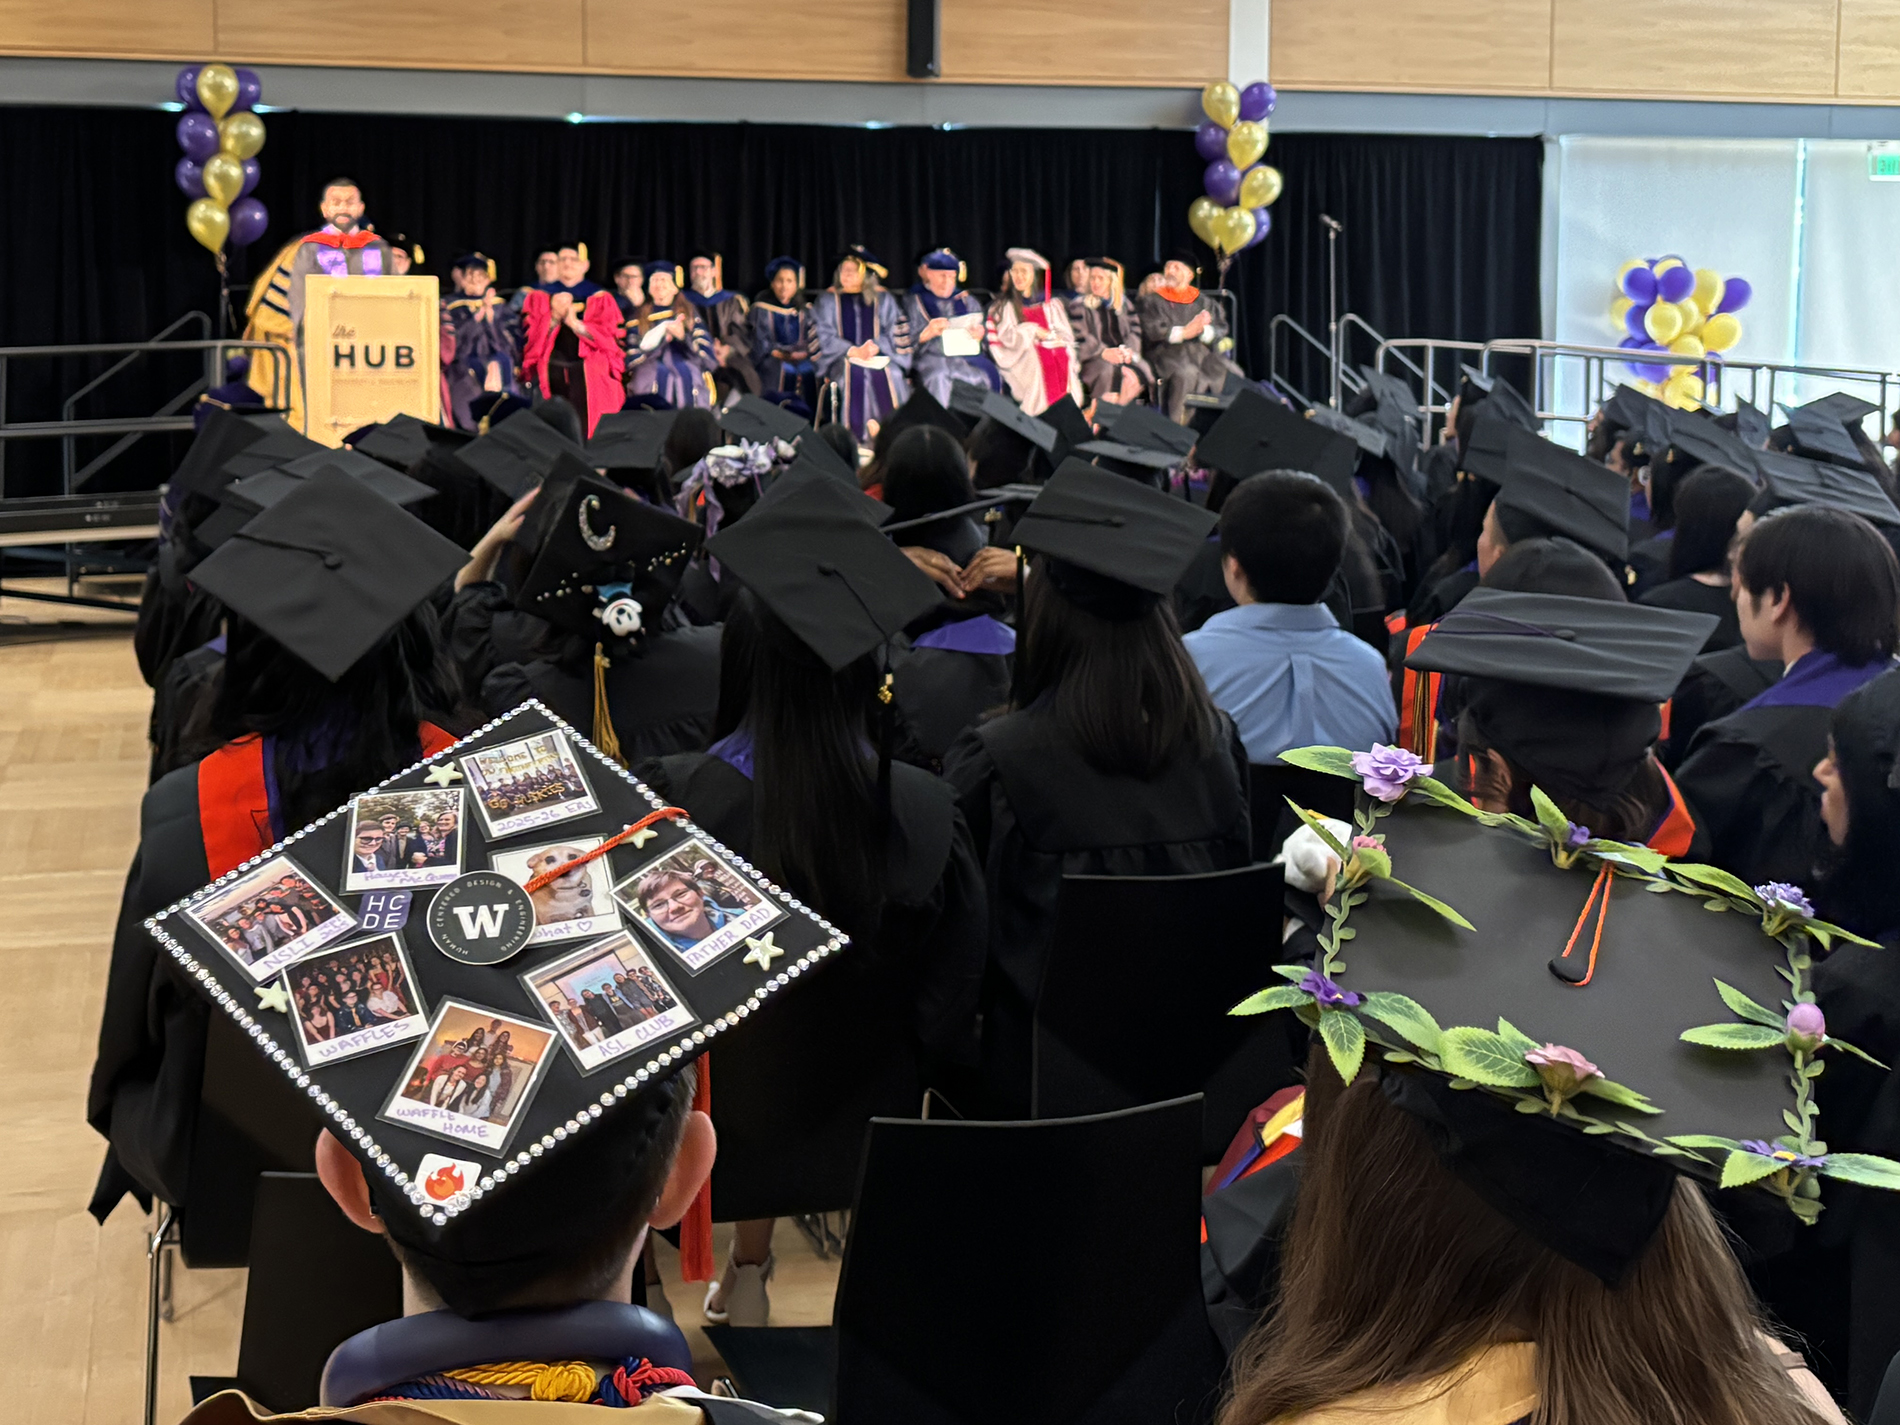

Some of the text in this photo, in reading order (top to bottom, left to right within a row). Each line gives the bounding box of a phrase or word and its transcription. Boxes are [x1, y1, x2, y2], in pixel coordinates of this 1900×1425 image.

[334, 344, 415, 369] HUB
[498, 810, 560, 832] 2025-26
[467, 879, 502, 889] DESIGN
[367, 895, 405, 912] HC
[436, 887, 461, 928] CENTERED
[362, 913, 402, 929] DE
[452, 903, 510, 940] W
[500, 899, 528, 952] ENGINEERING
[441, 933, 469, 956] HUMAN
[685, 908, 771, 965] FATHER DAD
[263, 937, 315, 970] NSLI
[319, 1022, 410, 1058] WAFFLES
[598, 1014, 675, 1058] ASL CLUB
[397, 1108, 455, 1121] WAFFLE
[443, 1122, 489, 1138] HOME
